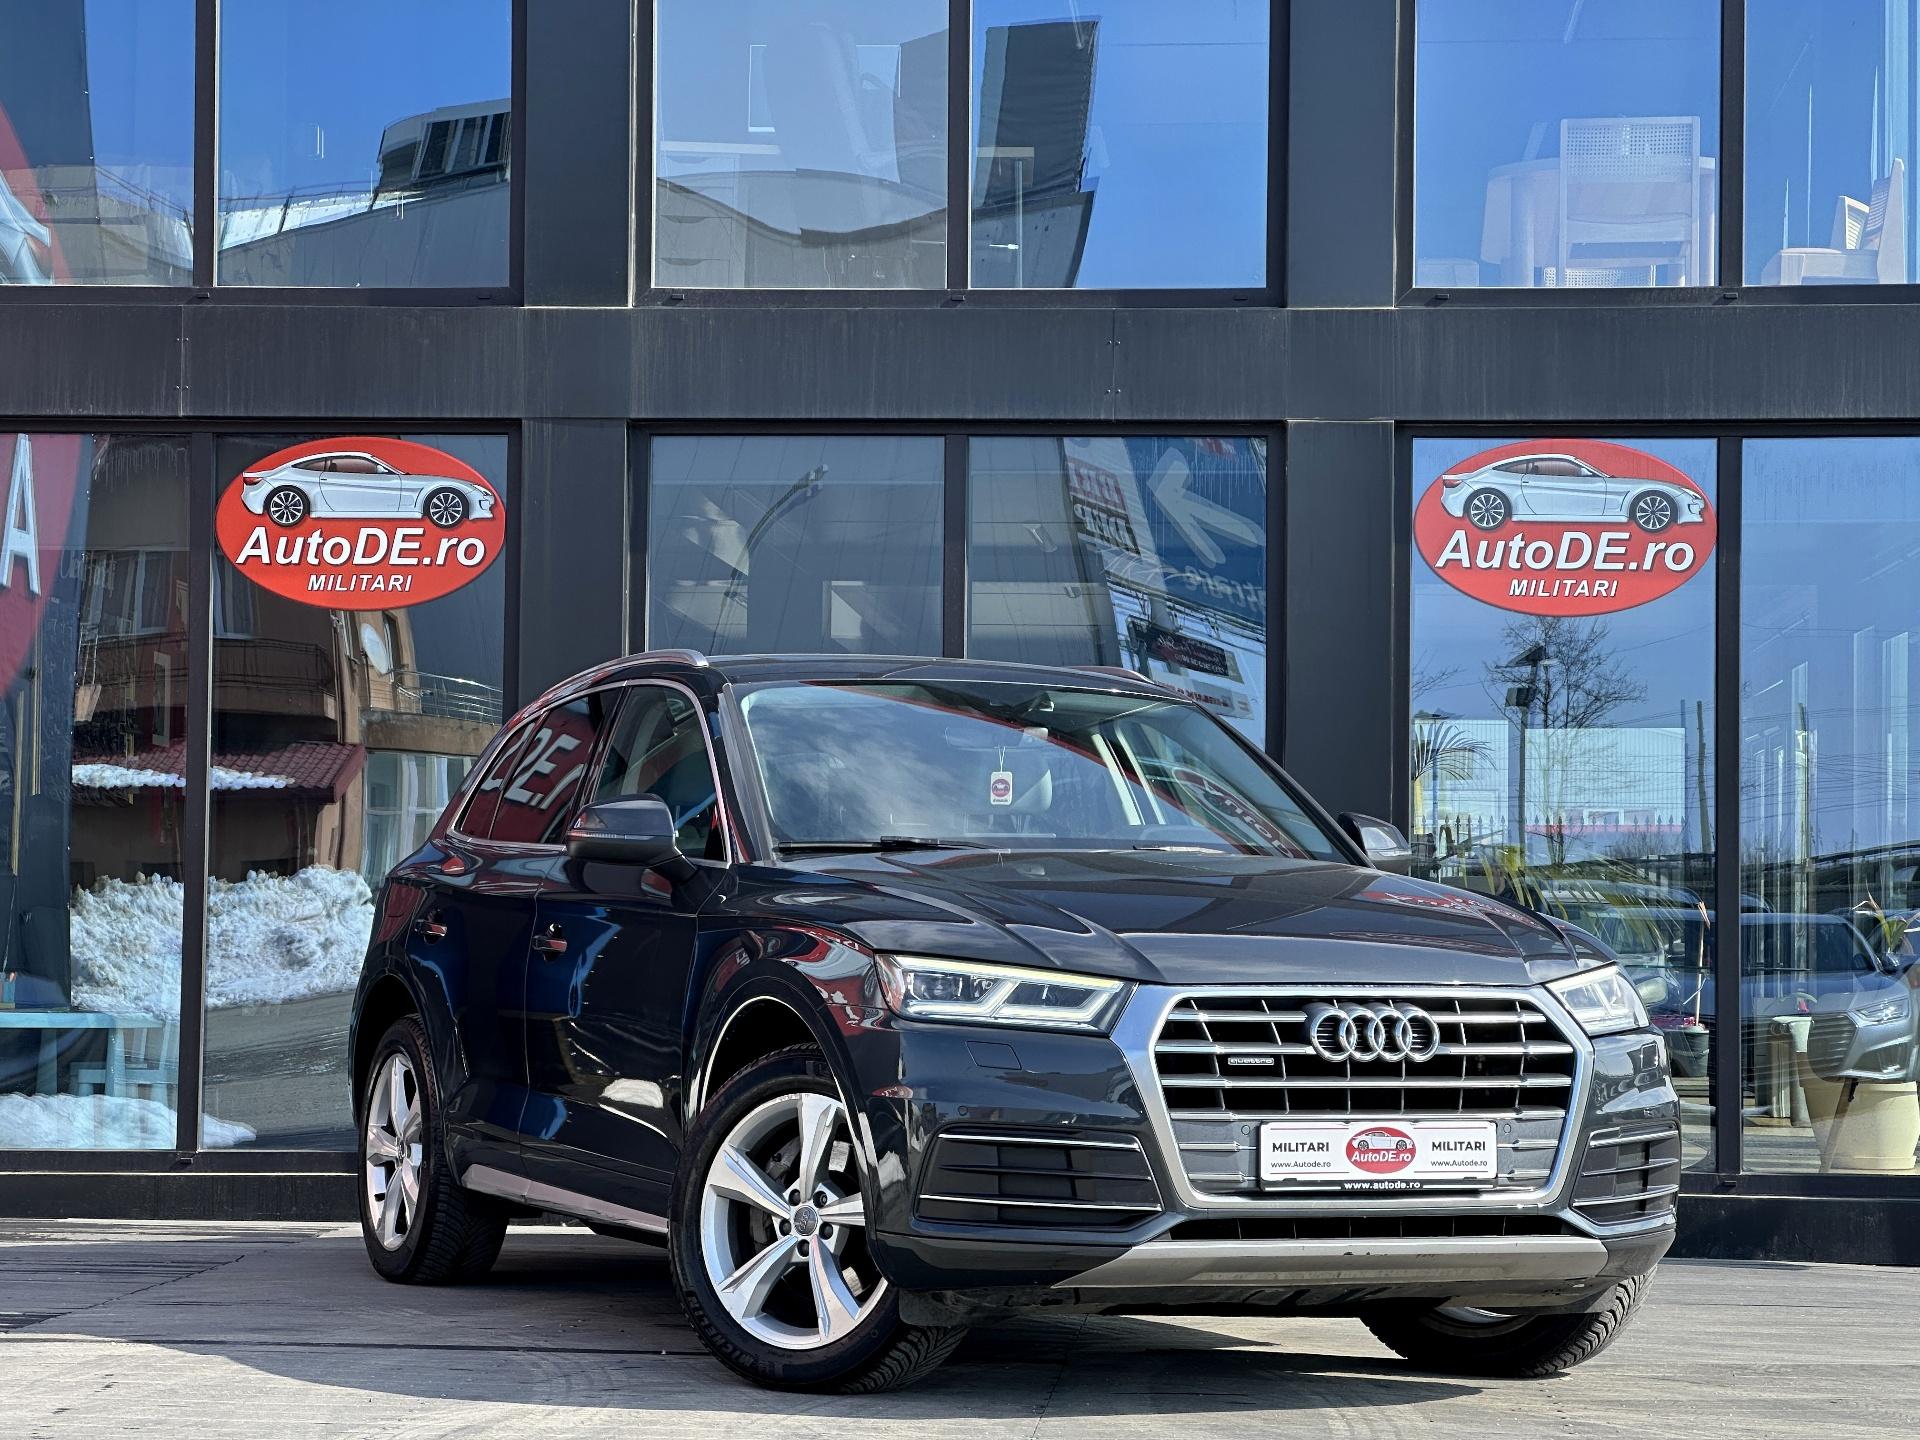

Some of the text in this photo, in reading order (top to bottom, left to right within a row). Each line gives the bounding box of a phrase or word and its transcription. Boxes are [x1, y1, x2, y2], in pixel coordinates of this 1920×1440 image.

[236, 526, 486, 566] AutoDE.ro
[1434, 529, 1695, 571] AutoDE.ro
[307, 574, 413, 592] MILITARI
[1509, 579, 1618, 597] MILITARI
[1229, 1057, 1274, 1065] quattro
[1272, 1141, 1330, 1152] MILITARI
[1431, 1140, 1486, 1151] MILITARI
[1351, 1150, 1412, 1162] AutoDE.ro
[1270, 1160, 1332, 1168] www.Autode.ro
[1430, 1159, 1488, 1167] www.Autode.ro
[1343, 1180, 1421, 1190] www.autode.ro
[685, 1293, 758, 1368] MICHELIN
